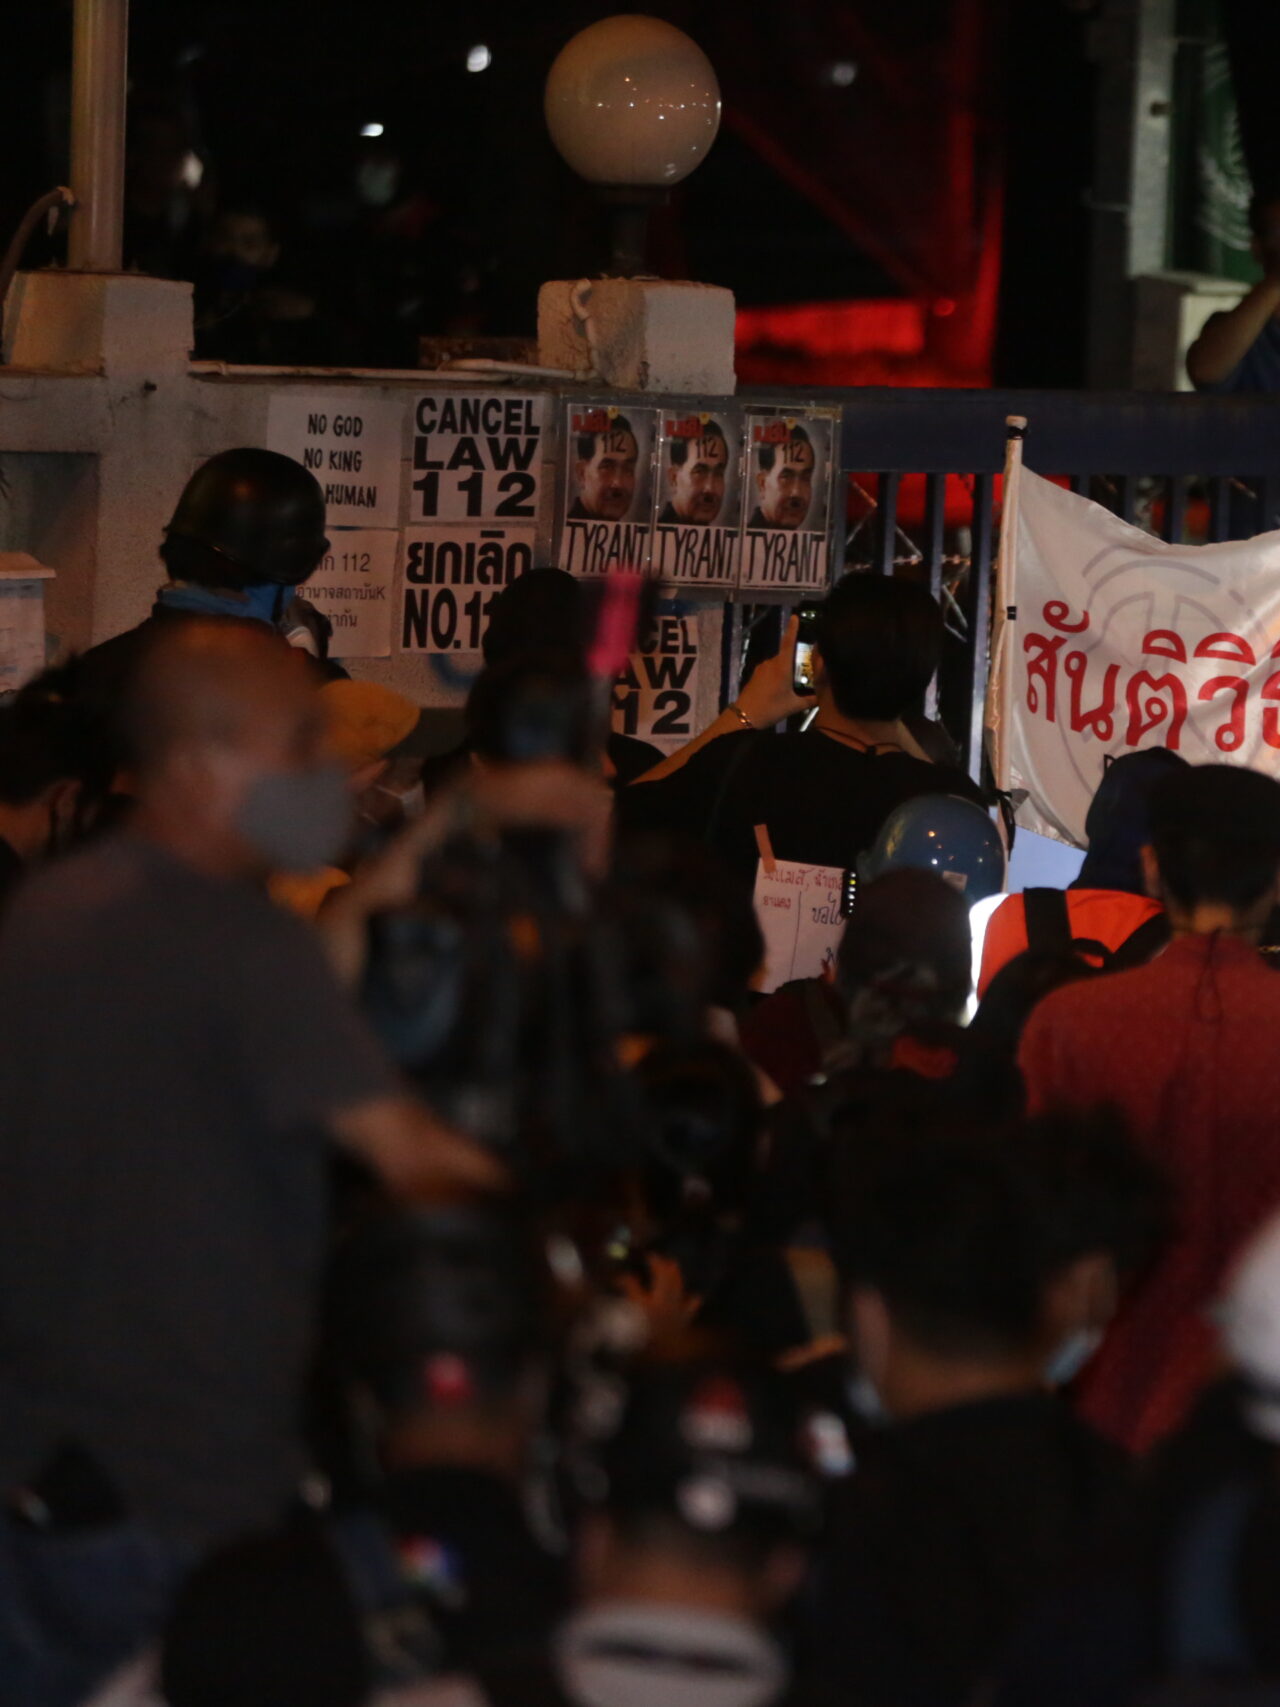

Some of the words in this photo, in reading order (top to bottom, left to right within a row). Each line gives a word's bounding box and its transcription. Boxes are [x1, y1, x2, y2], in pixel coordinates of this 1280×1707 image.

[308, 414, 327, 435] NO
[333, 416, 363, 437] GOD
[415, 397, 541, 436] CANCEL
[414, 436, 539, 471] LAW
[602, 431, 626, 454] 112
[696, 438, 718, 459] 112
[782, 441, 804, 464] 112
[304, 448, 323, 468] NO
[329, 449, 363, 472] KING
[325, 484, 377, 508] HUMAN
[412, 471, 537, 517] 112
[342, 553, 371, 572] 112
[405, 530, 532, 585] ยกเลิก
[566, 522, 649, 575] TYRANT
[656, 526, 739, 579] TYRANT
[746, 531, 826, 583] TYRANT
[612, 656, 697, 690] AW
[612, 690, 691, 735] 12
